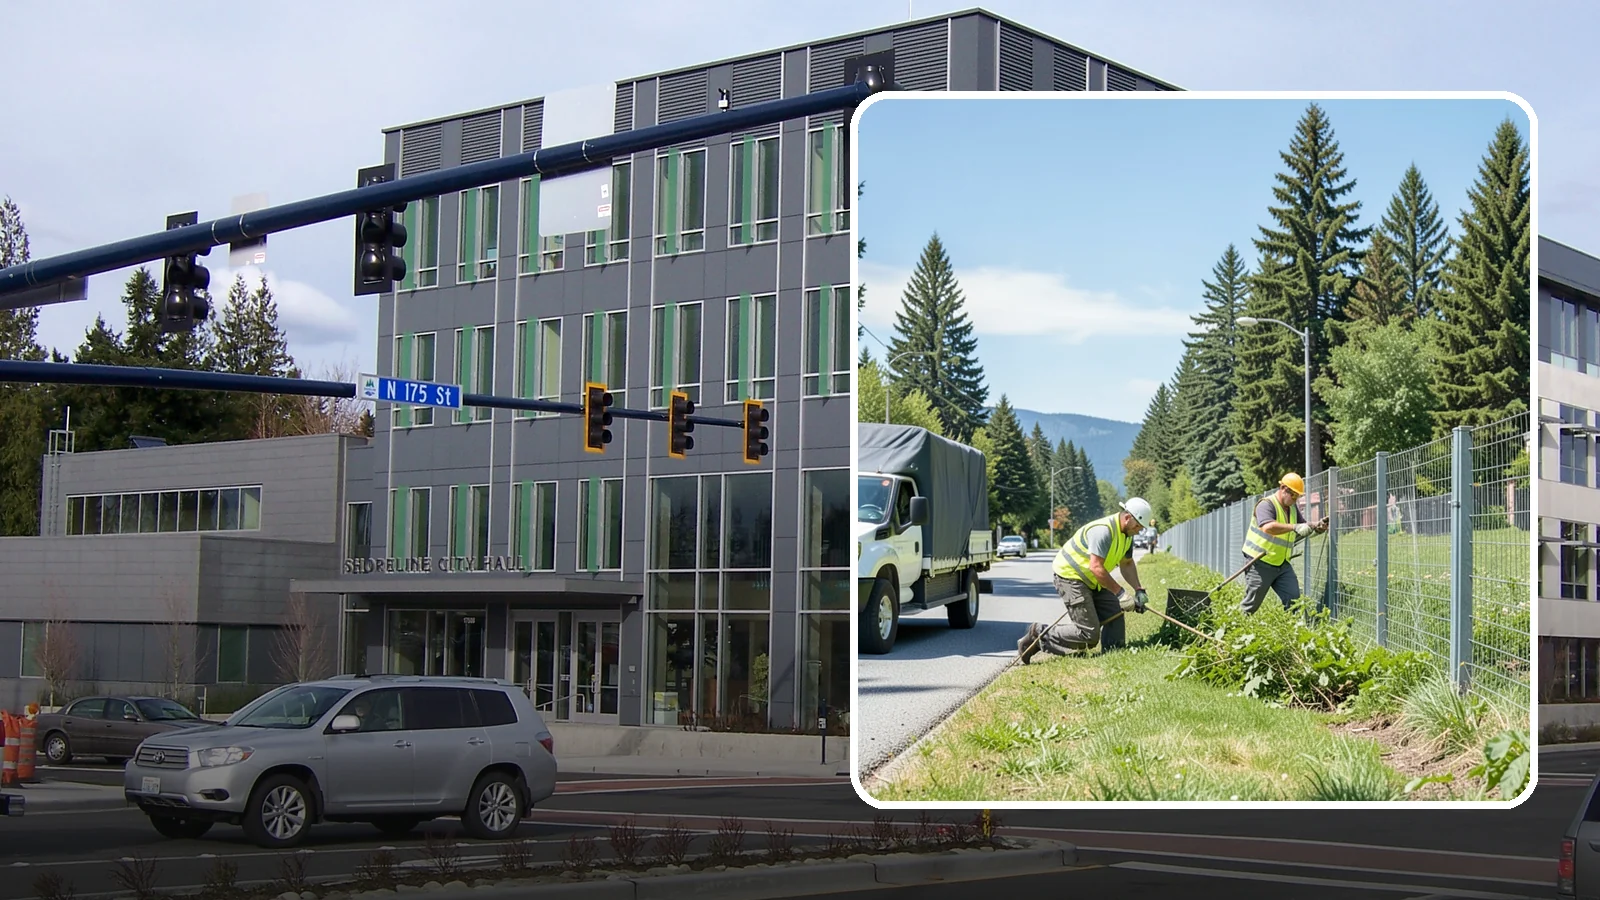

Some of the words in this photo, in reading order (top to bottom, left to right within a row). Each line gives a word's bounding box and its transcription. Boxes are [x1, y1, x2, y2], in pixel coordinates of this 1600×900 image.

[387, 380, 396, 400] N
[405, 382, 427, 403] 175
[436, 386, 451, 406] St
[344, 557, 432, 573] SHORELINE
[438, 556, 475, 572] CITY
[484, 555, 525, 572] HALL
